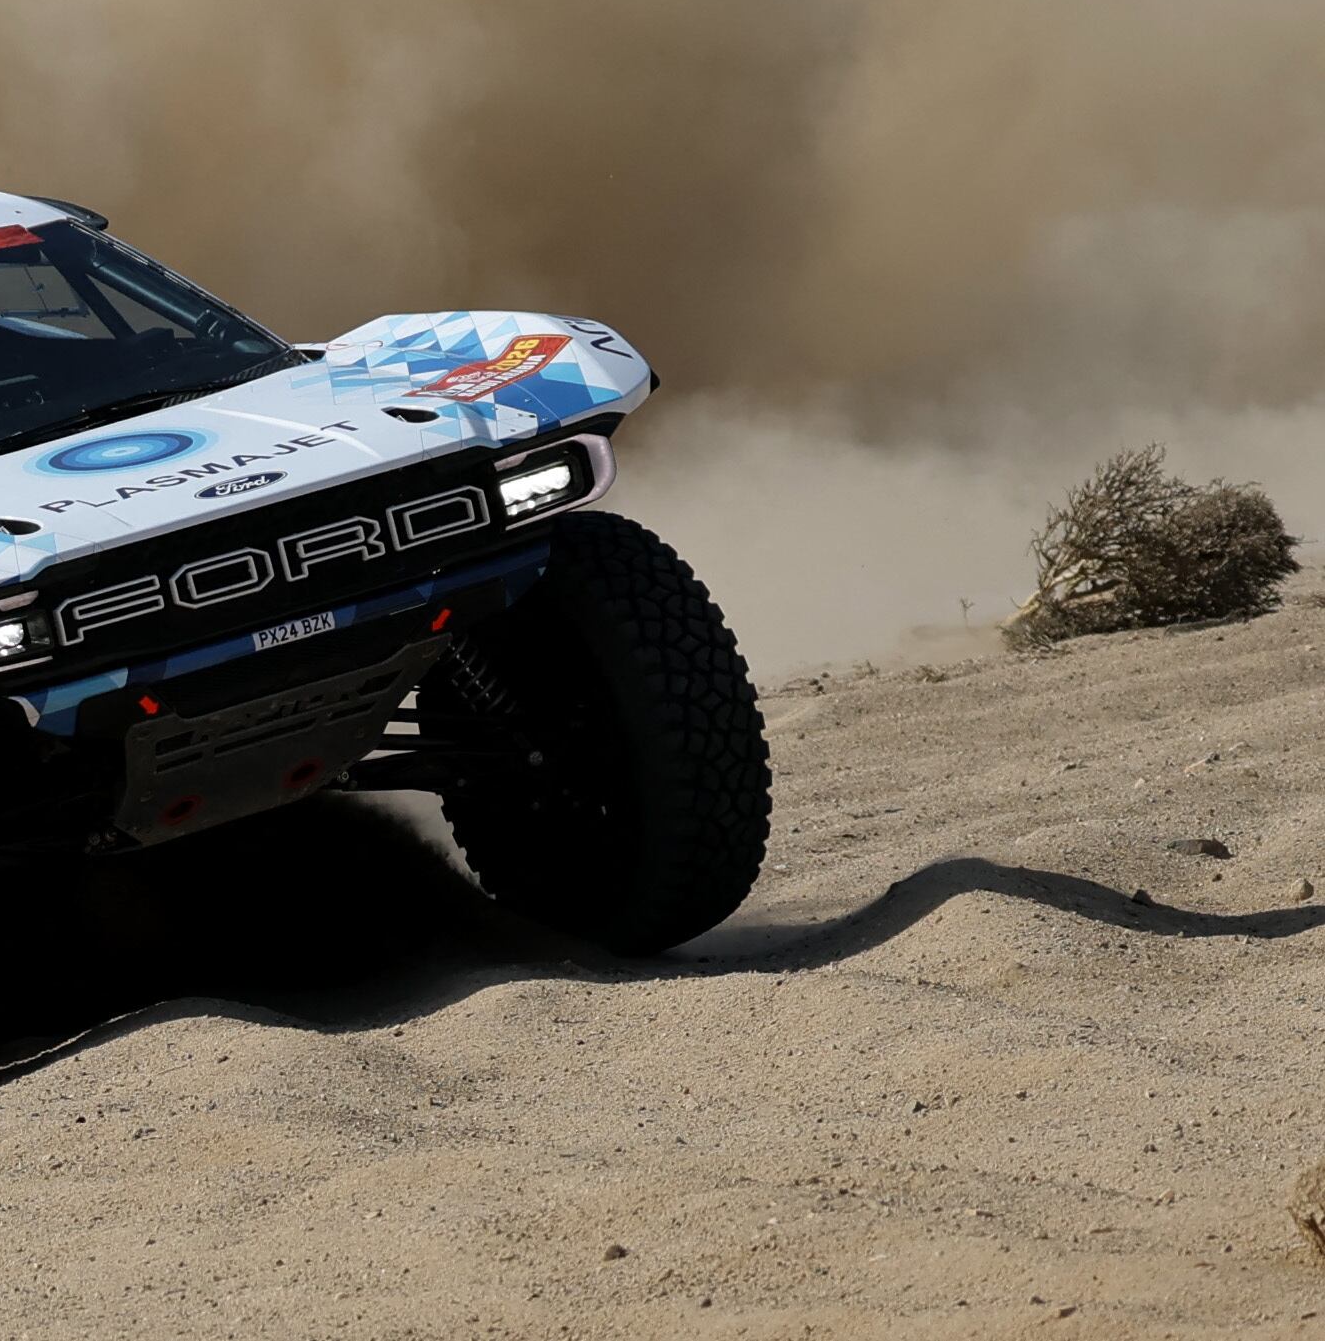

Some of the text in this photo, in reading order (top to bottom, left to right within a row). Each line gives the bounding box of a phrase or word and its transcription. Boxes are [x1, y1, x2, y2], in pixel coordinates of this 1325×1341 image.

[485, 339, 541, 371] 2026
[39, 420, 359, 514] PLASMAJET
[215, 475, 271, 496] Ford
[54, 486, 491, 646] FORD
[258, 613, 332, 648] PX24 BZK
